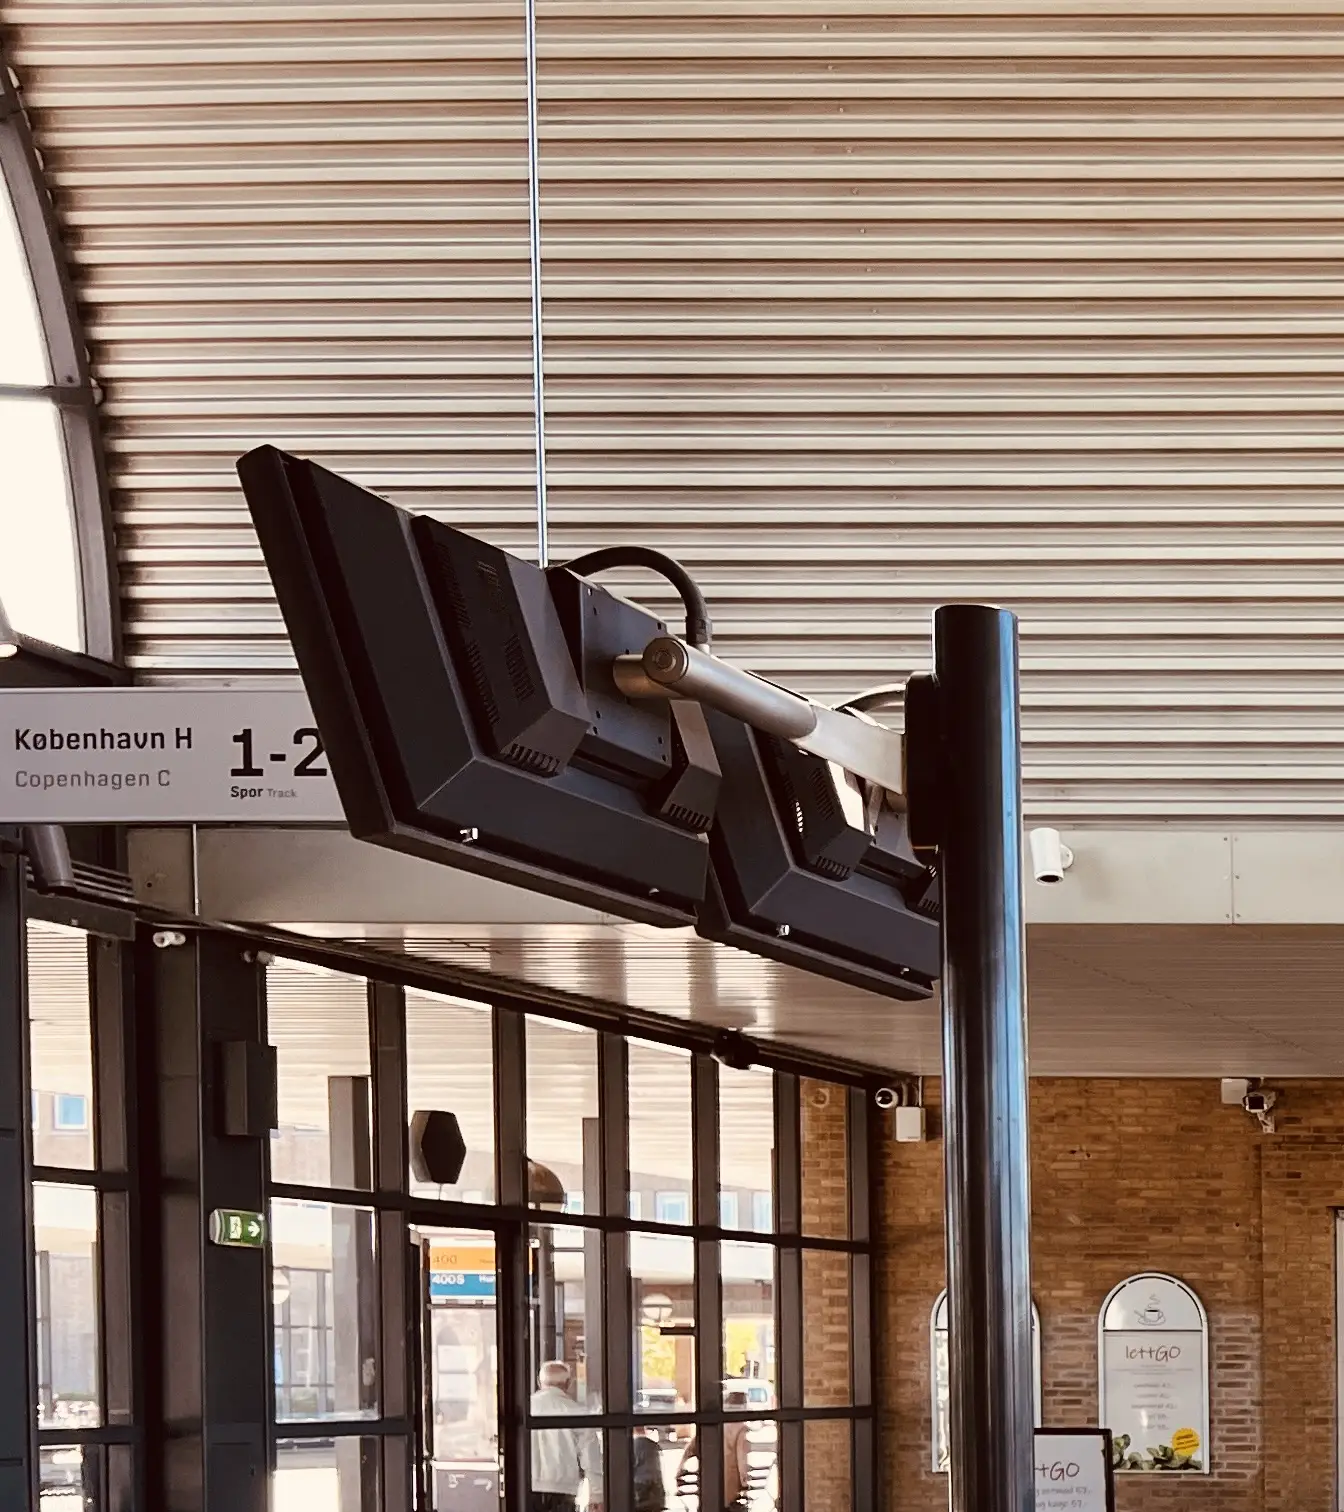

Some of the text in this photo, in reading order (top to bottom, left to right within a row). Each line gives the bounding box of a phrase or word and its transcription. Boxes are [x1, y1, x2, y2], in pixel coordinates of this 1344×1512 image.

[15, 727, 193, 751] København H
[15, 769, 171, 790] Copenhagen C
[230, 786, 298, 800] Spor Track
[1125, 1345, 1181, 1362] lettGO
